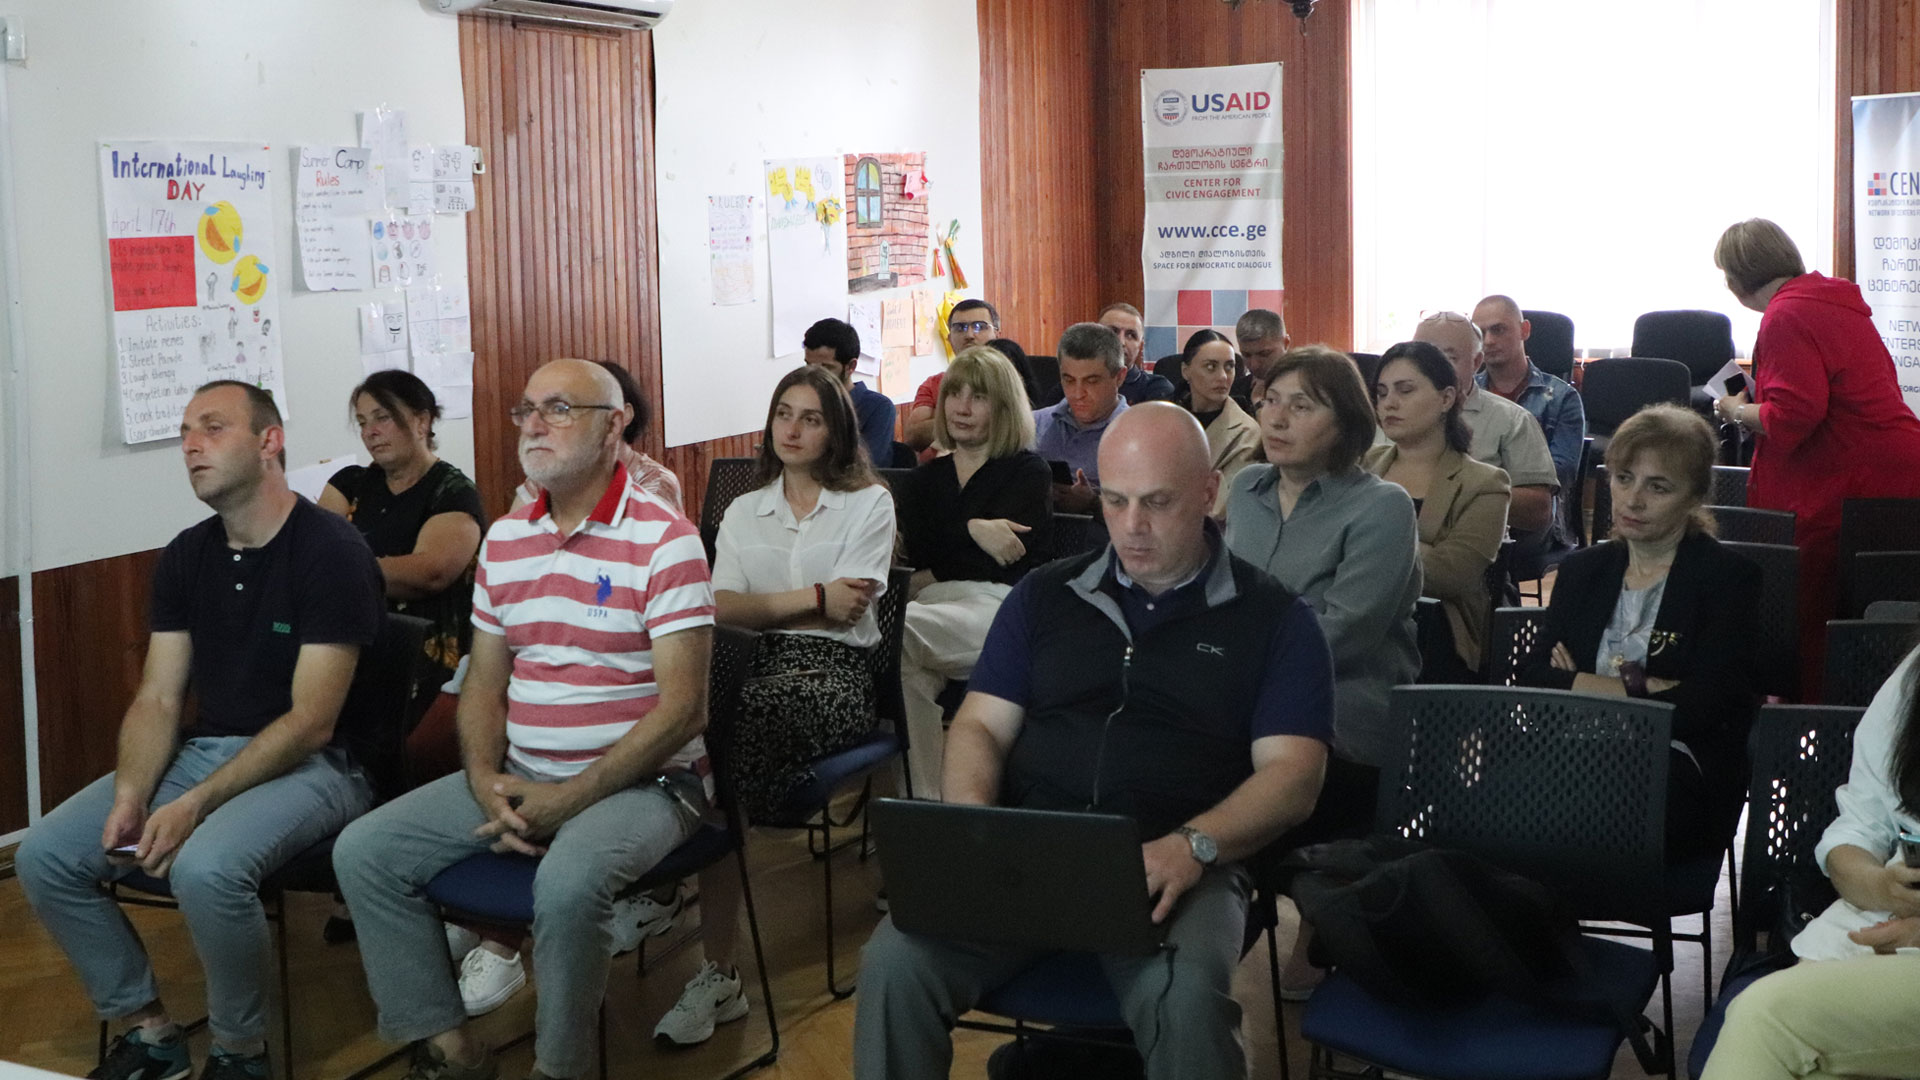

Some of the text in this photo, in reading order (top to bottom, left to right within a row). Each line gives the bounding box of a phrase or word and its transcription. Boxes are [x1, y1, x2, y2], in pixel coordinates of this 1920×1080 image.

[1191, 91, 1271, 113] USAID
[1172, 146, 1253, 158] დემოკრატიული
[112, 150, 266, 190] International Laughing
[1158, 158, 1269, 171] ჩართულობის ცენტრი
[316, 170, 340, 188] Rules
[1183, 178, 1241, 188] CENTER FOR
[1890, 172, 1920, 196] CEN
[167, 179, 206, 200] DAY
[1165, 188, 1261, 200] CIVIC ENGAGEMENT
[1158, 224, 1267, 241] www.cce.ge
[1152, 262, 1175, 270] SPACE
[1176, 262, 1190, 270] FOR
[1882, 258, 1920, 272] ჩართ
[1891, 354, 1920, 368] NGA
[587, 608, 608, 618] USPA
[1196, 642, 1224, 656] CK
